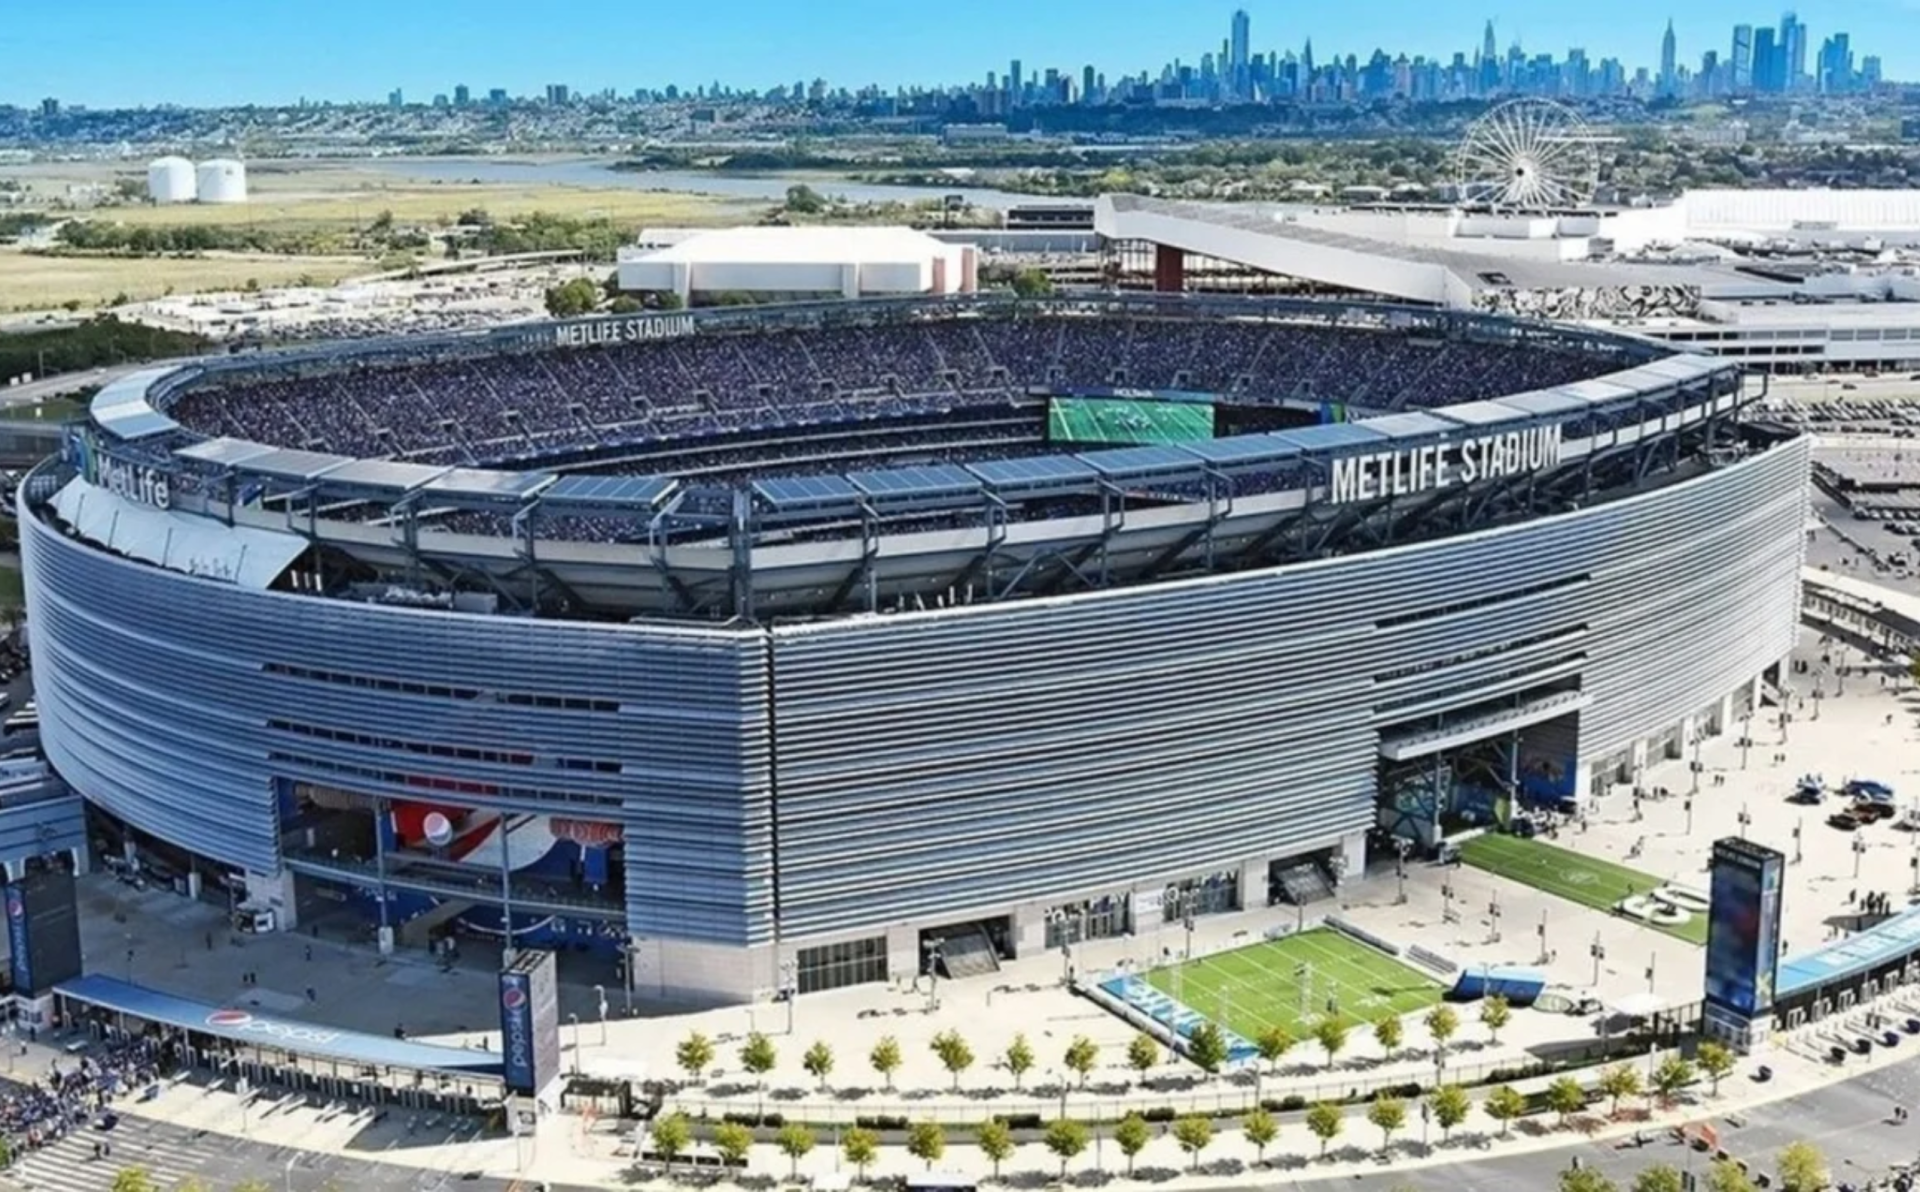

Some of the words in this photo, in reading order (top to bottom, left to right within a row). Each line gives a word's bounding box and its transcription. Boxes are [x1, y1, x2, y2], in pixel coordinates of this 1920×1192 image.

[556, 320, 621, 346] METLIFE
[624, 315, 695, 340] STADIUM
[97, 453, 170, 509] MetLife
[1331, 443, 1450, 504] METLIFE
[1460, 423, 1562, 483] STADIUM
[238, 1019, 341, 1044] pepsi
[507, 1008, 528, 1068] pepsi
